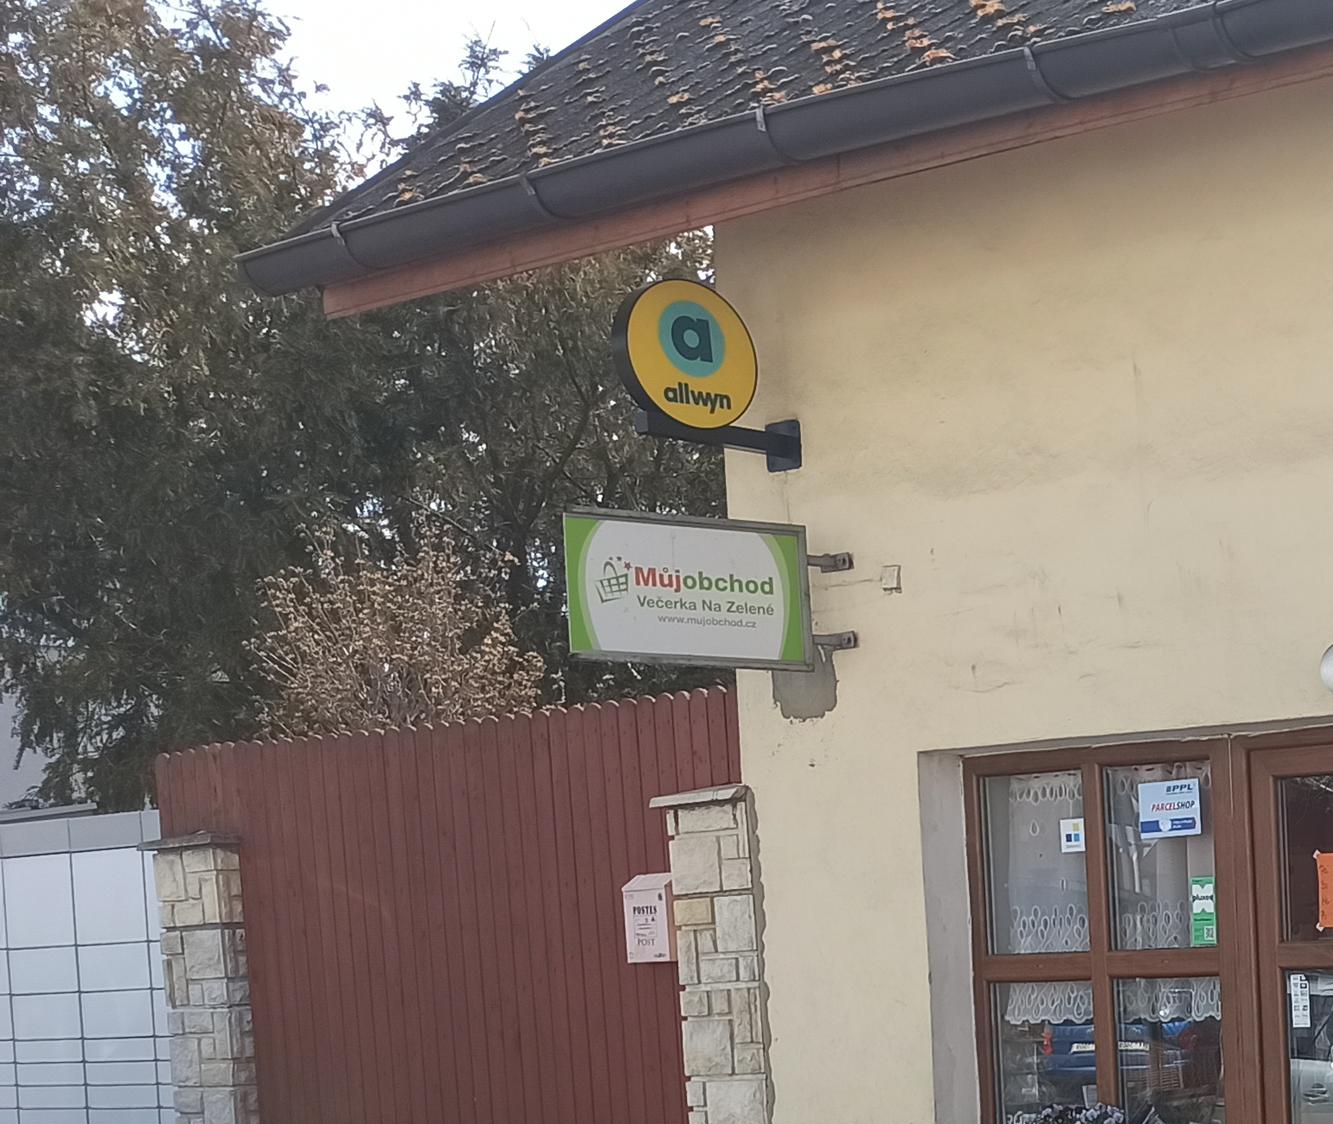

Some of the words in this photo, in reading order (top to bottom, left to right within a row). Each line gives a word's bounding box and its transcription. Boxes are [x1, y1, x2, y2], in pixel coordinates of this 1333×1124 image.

[663, 381, 731, 414] allwyn
[634, 566, 775, 596] Můjobchod
[637, 595, 697, 611] Večerka
[702, 599, 722, 613] Na
[726, 601, 775, 616] Zelené
[657, 615, 757, 629] www.mujobchod.cz
[632, 905, 658, 915] POSTES
[637, 938, 656, 946] POST
